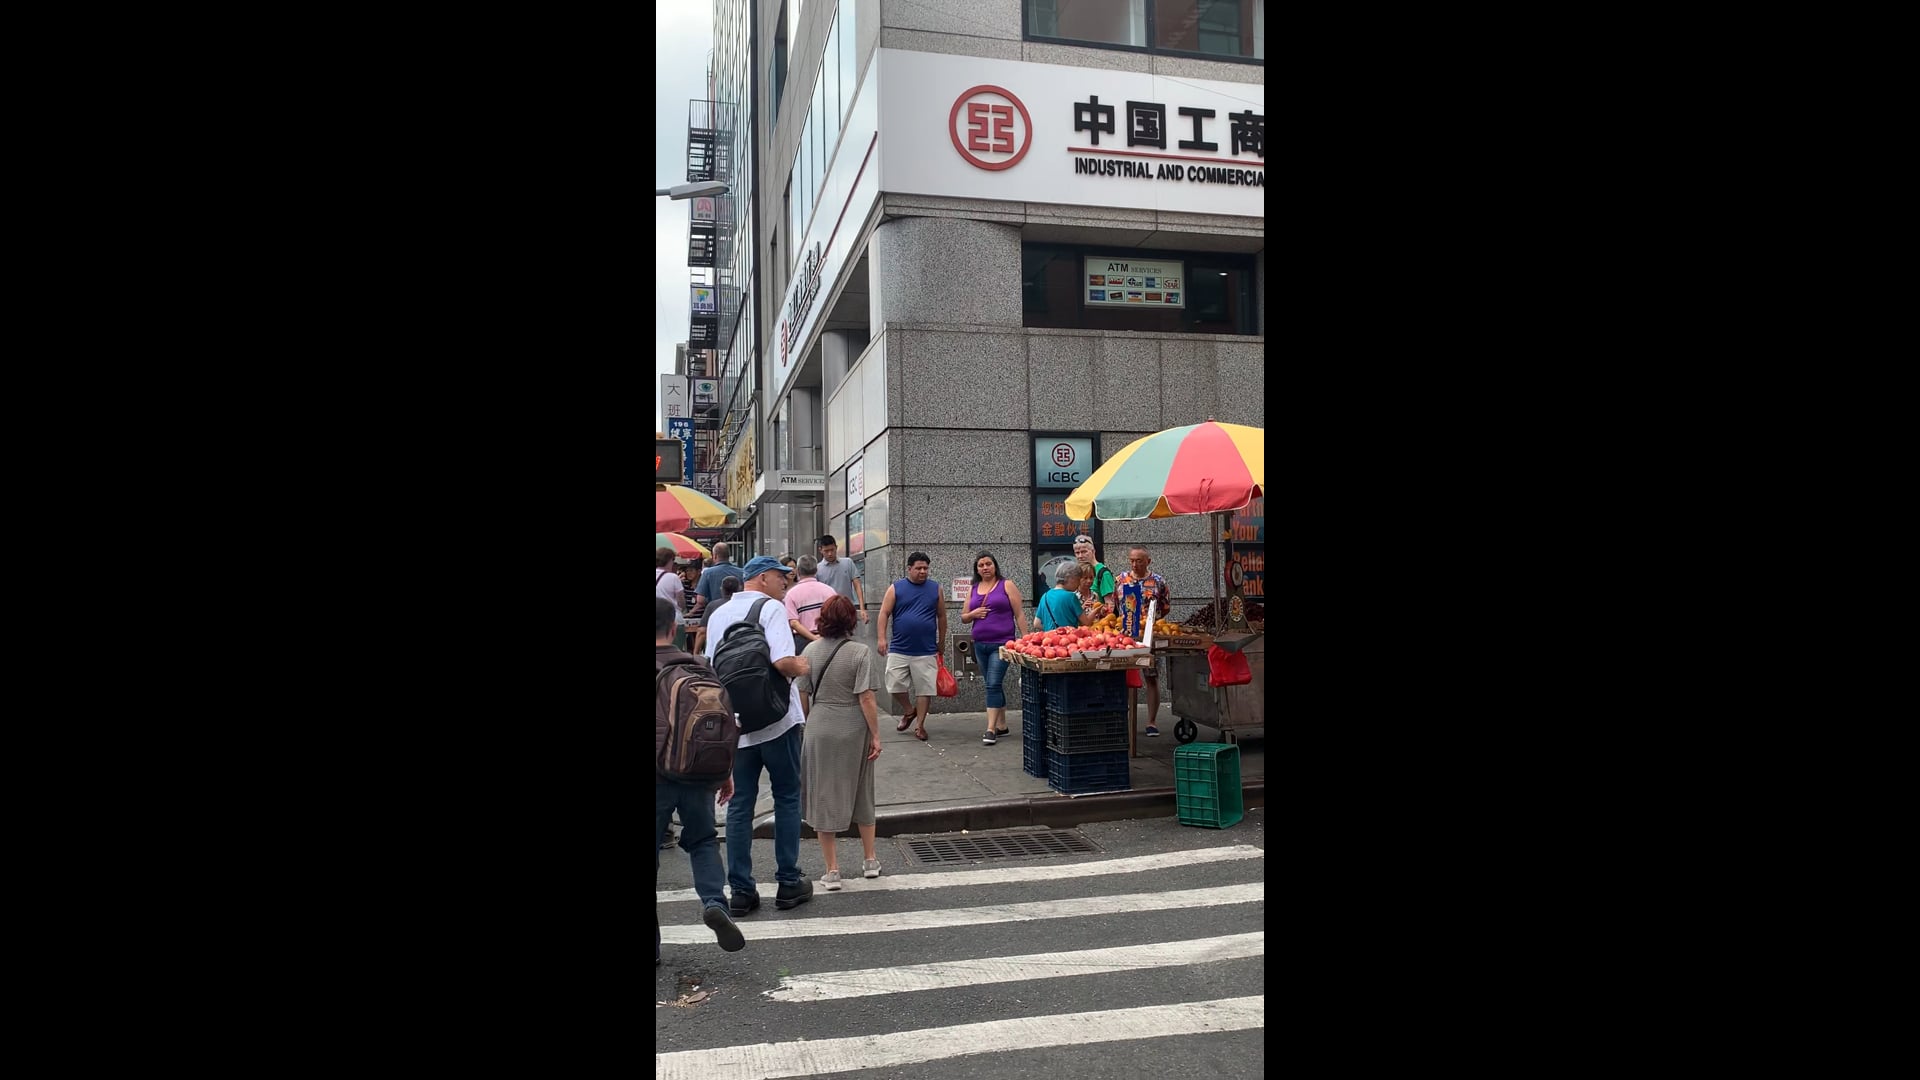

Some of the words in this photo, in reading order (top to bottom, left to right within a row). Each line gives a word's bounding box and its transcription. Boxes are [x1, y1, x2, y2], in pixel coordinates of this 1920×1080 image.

[1074, 95, 1264, 158] 中国工商
[1075, 157, 1153, 179] INDUSTRIAL
[1156, 163, 1184, 182] AND
[1187, 166, 1264, 188] COMMERCIA
[1107, 263, 1129, 273] ATM
[781, 476, 797, 484] ATM
[1048, 471, 1080, 483] ICBC
[1232, 520, 1260, 541] Your
[1232, 551, 1264, 573] Relia
[1243, 574, 1264, 596] ank
